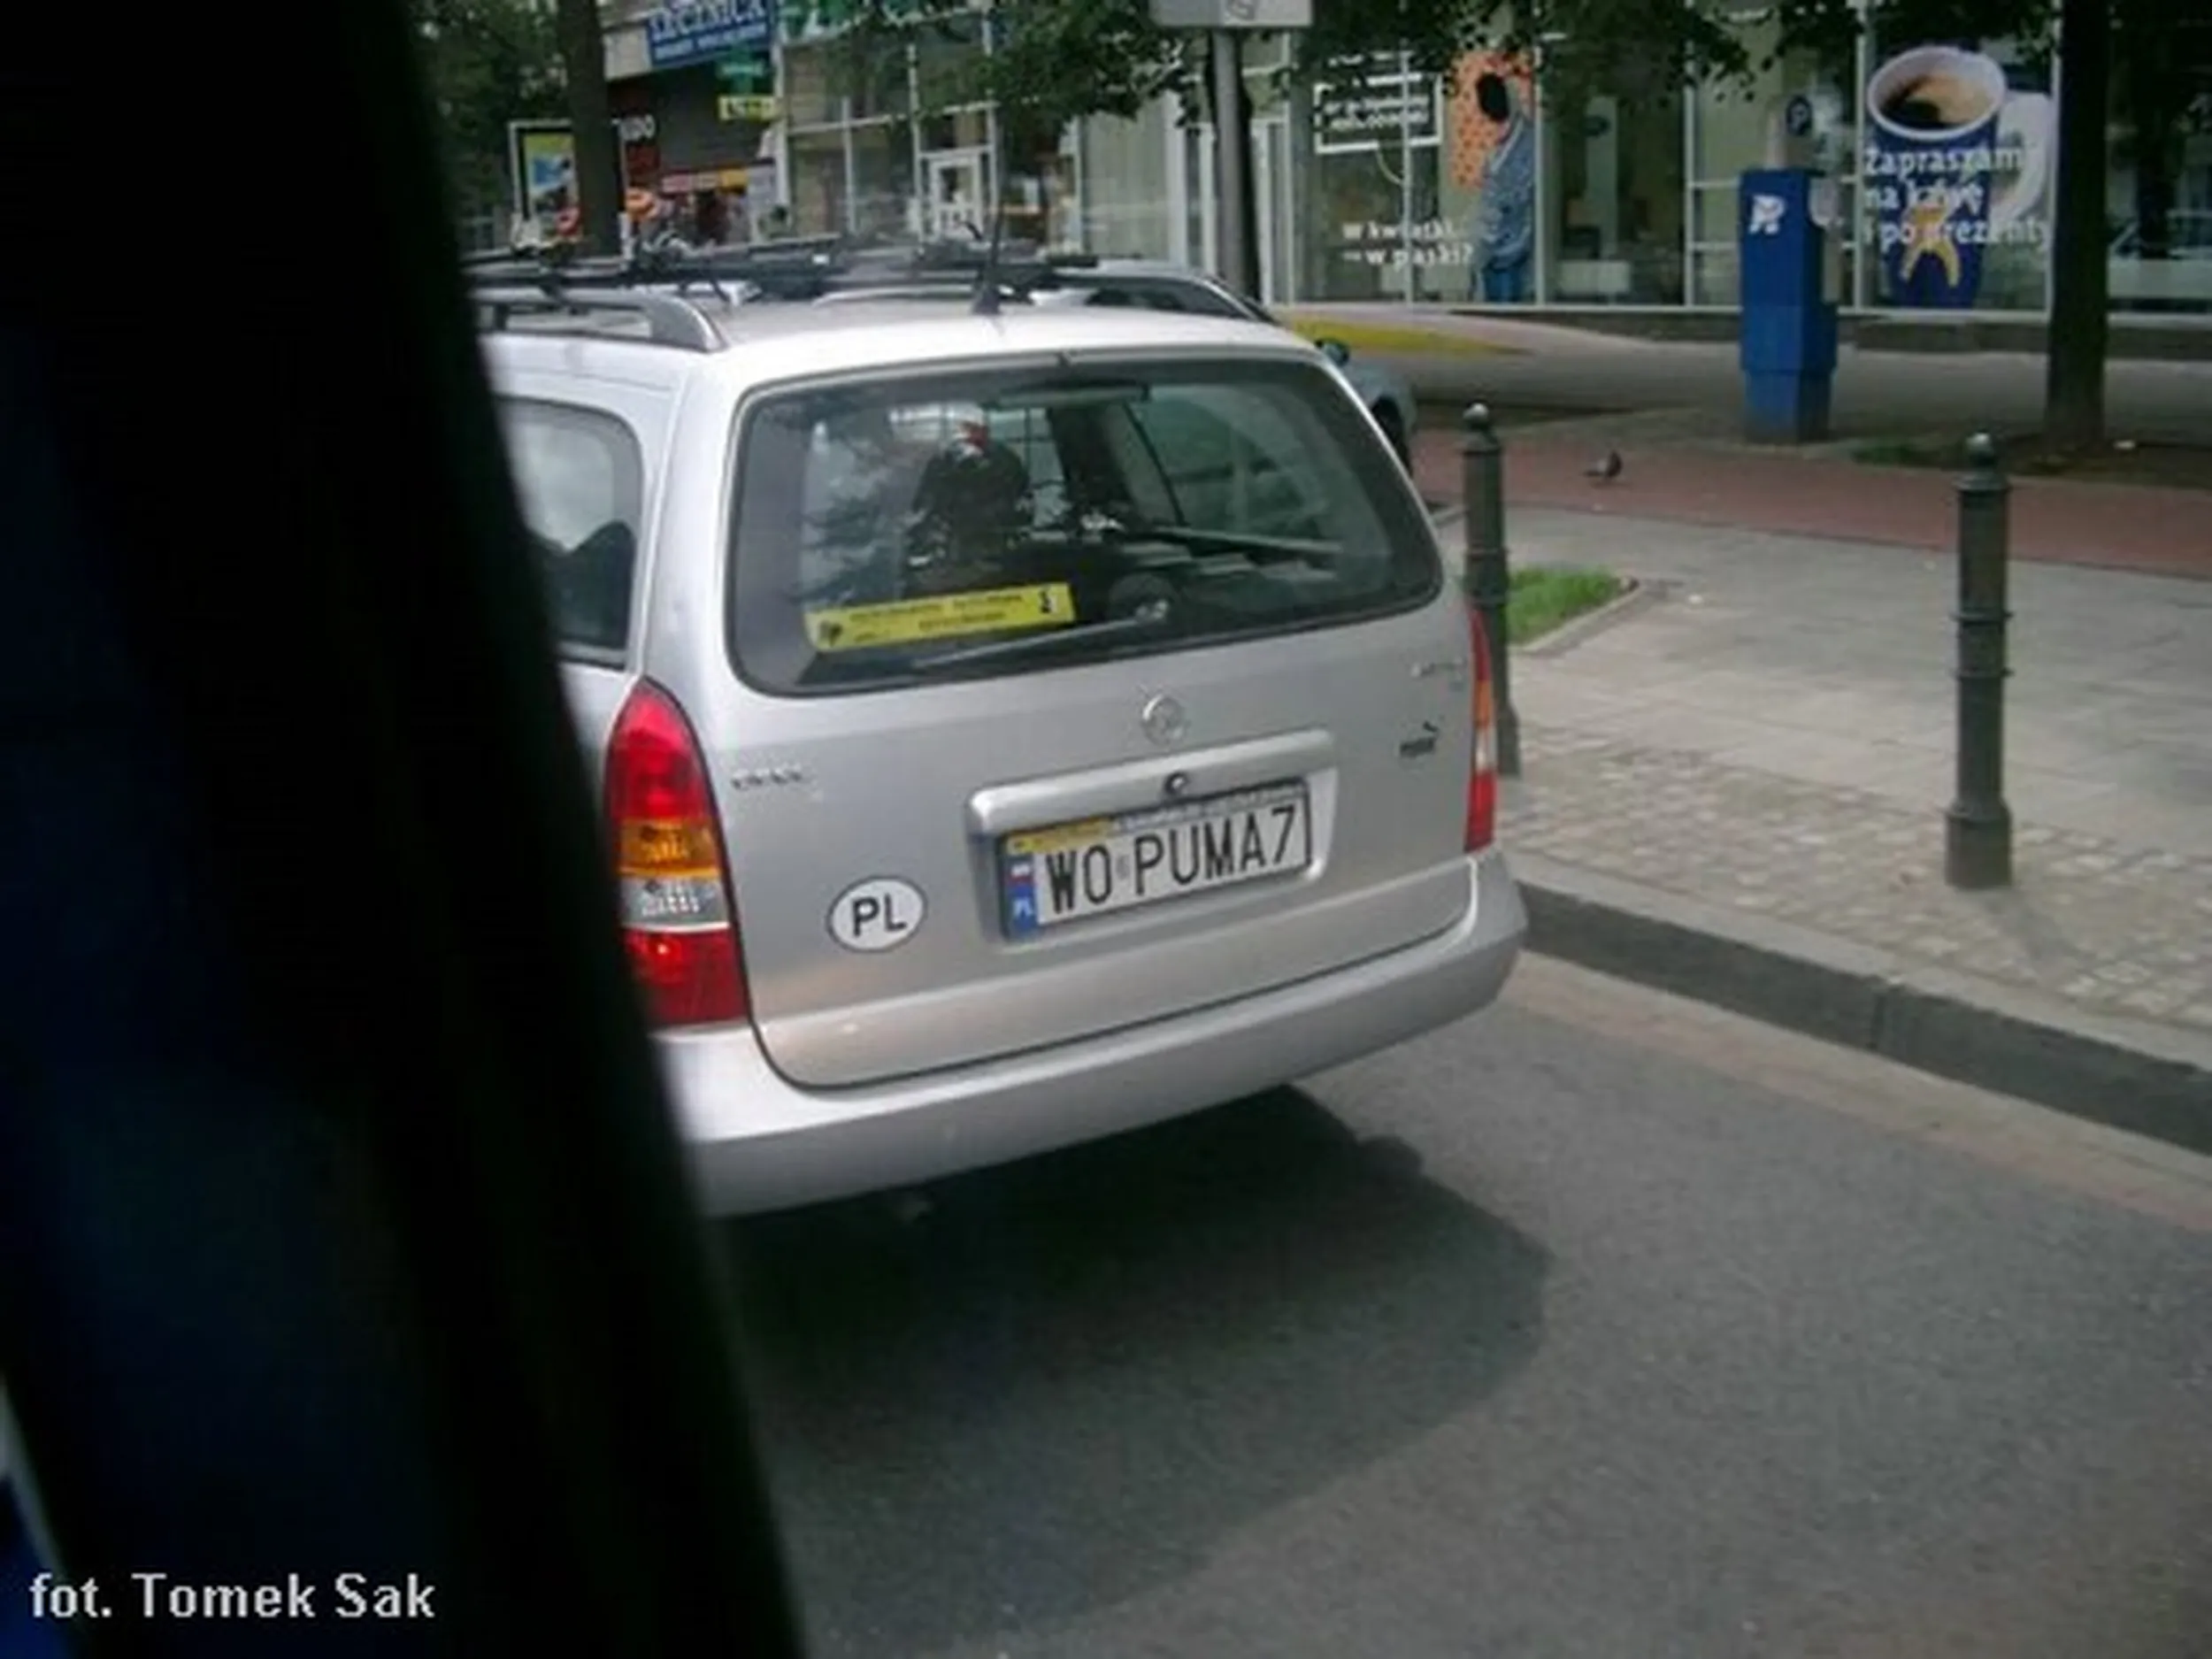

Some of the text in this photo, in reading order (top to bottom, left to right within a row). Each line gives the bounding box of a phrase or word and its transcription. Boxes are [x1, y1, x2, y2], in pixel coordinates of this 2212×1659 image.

[1046, 845, 1112, 914] WO
[1133, 803, 1295, 896] PUMA7
[852, 892, 908, 938] PL
